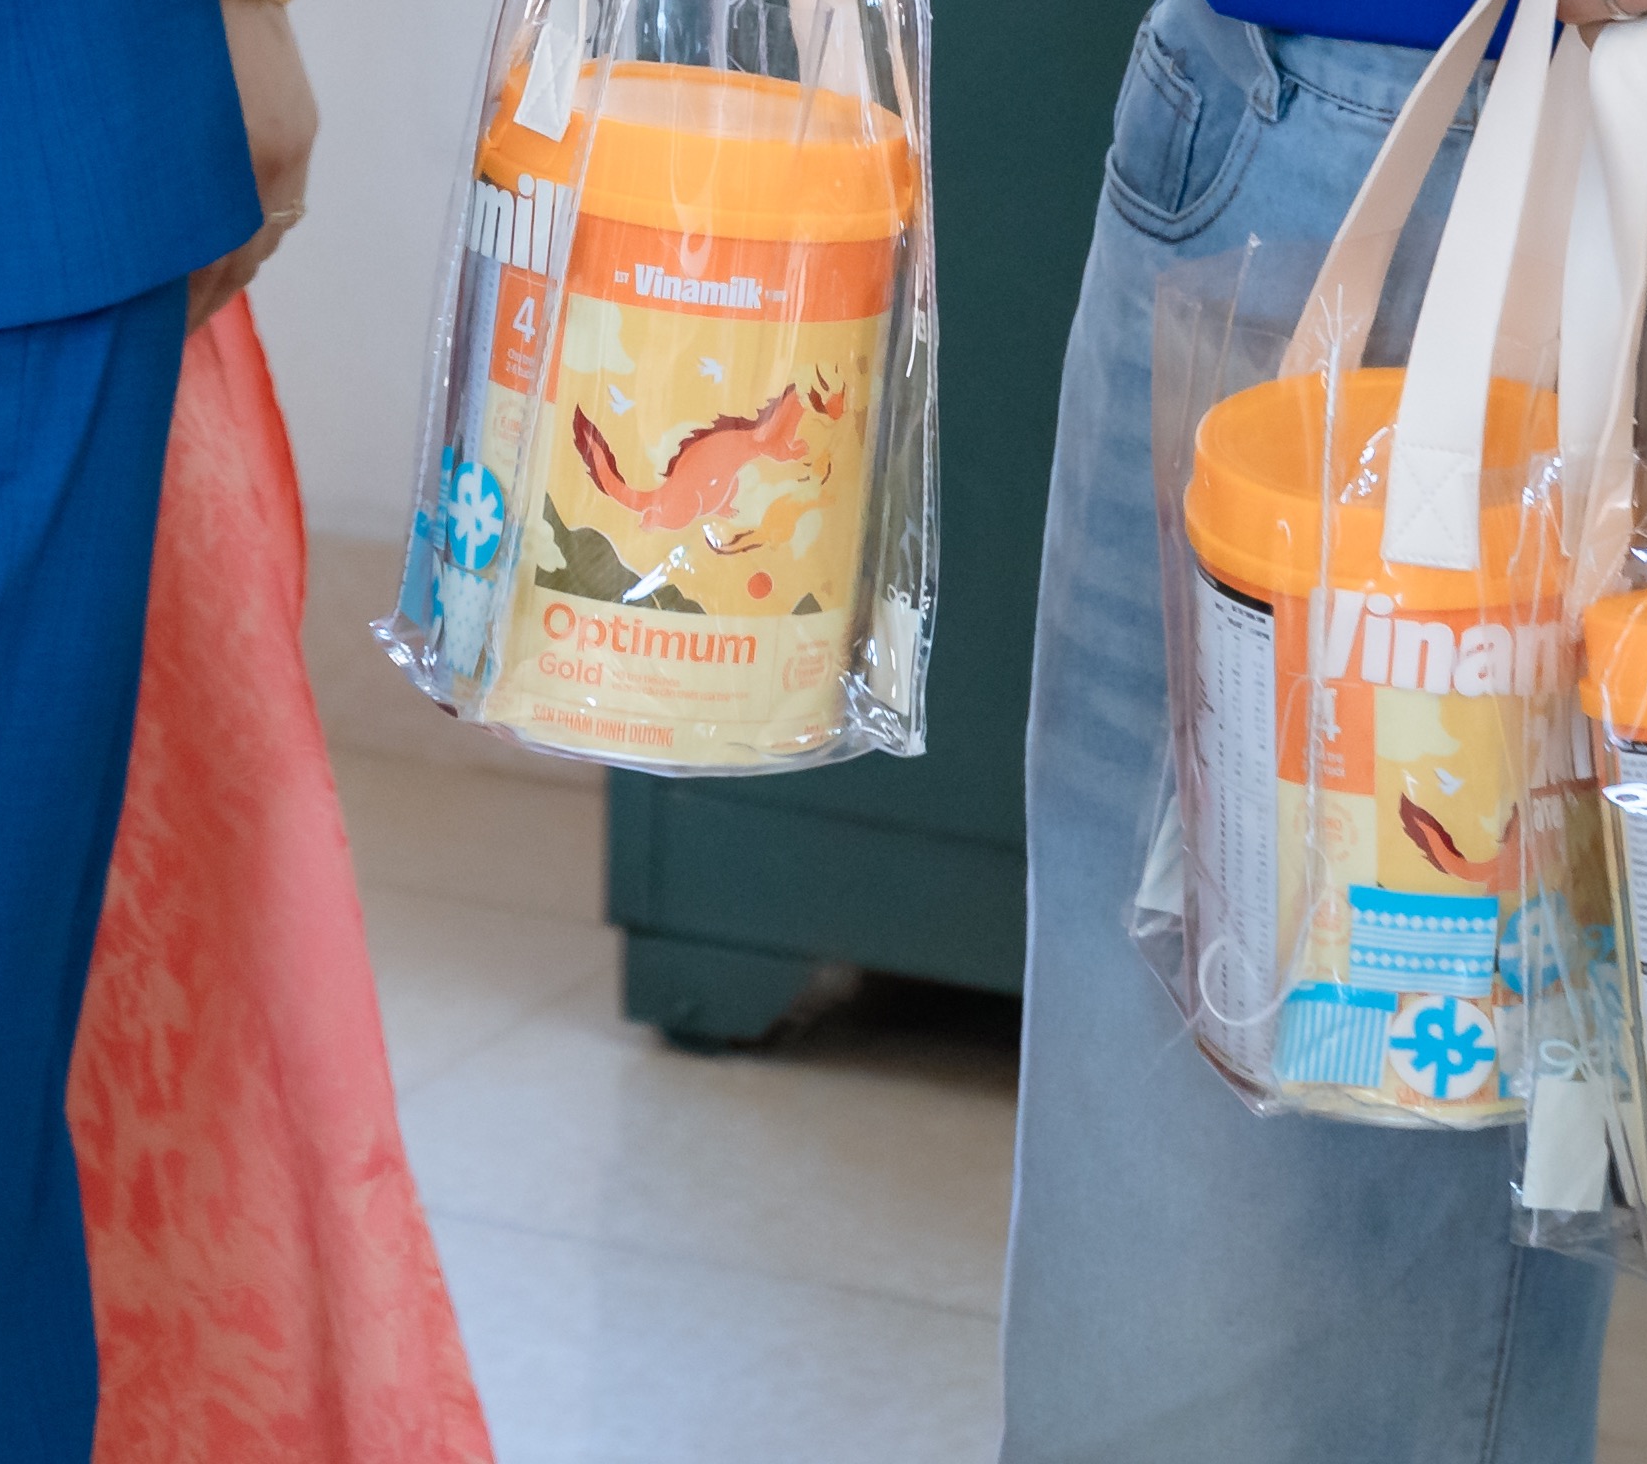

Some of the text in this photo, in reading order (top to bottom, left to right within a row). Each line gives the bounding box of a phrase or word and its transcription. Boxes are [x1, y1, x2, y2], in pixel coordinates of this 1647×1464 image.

[634, 263, 763, 309] Vinamilk
[512, 295, 536, 343] 4
[543, 602, 758, 665] Optimum
[538, 651, 603, 687] Gold
